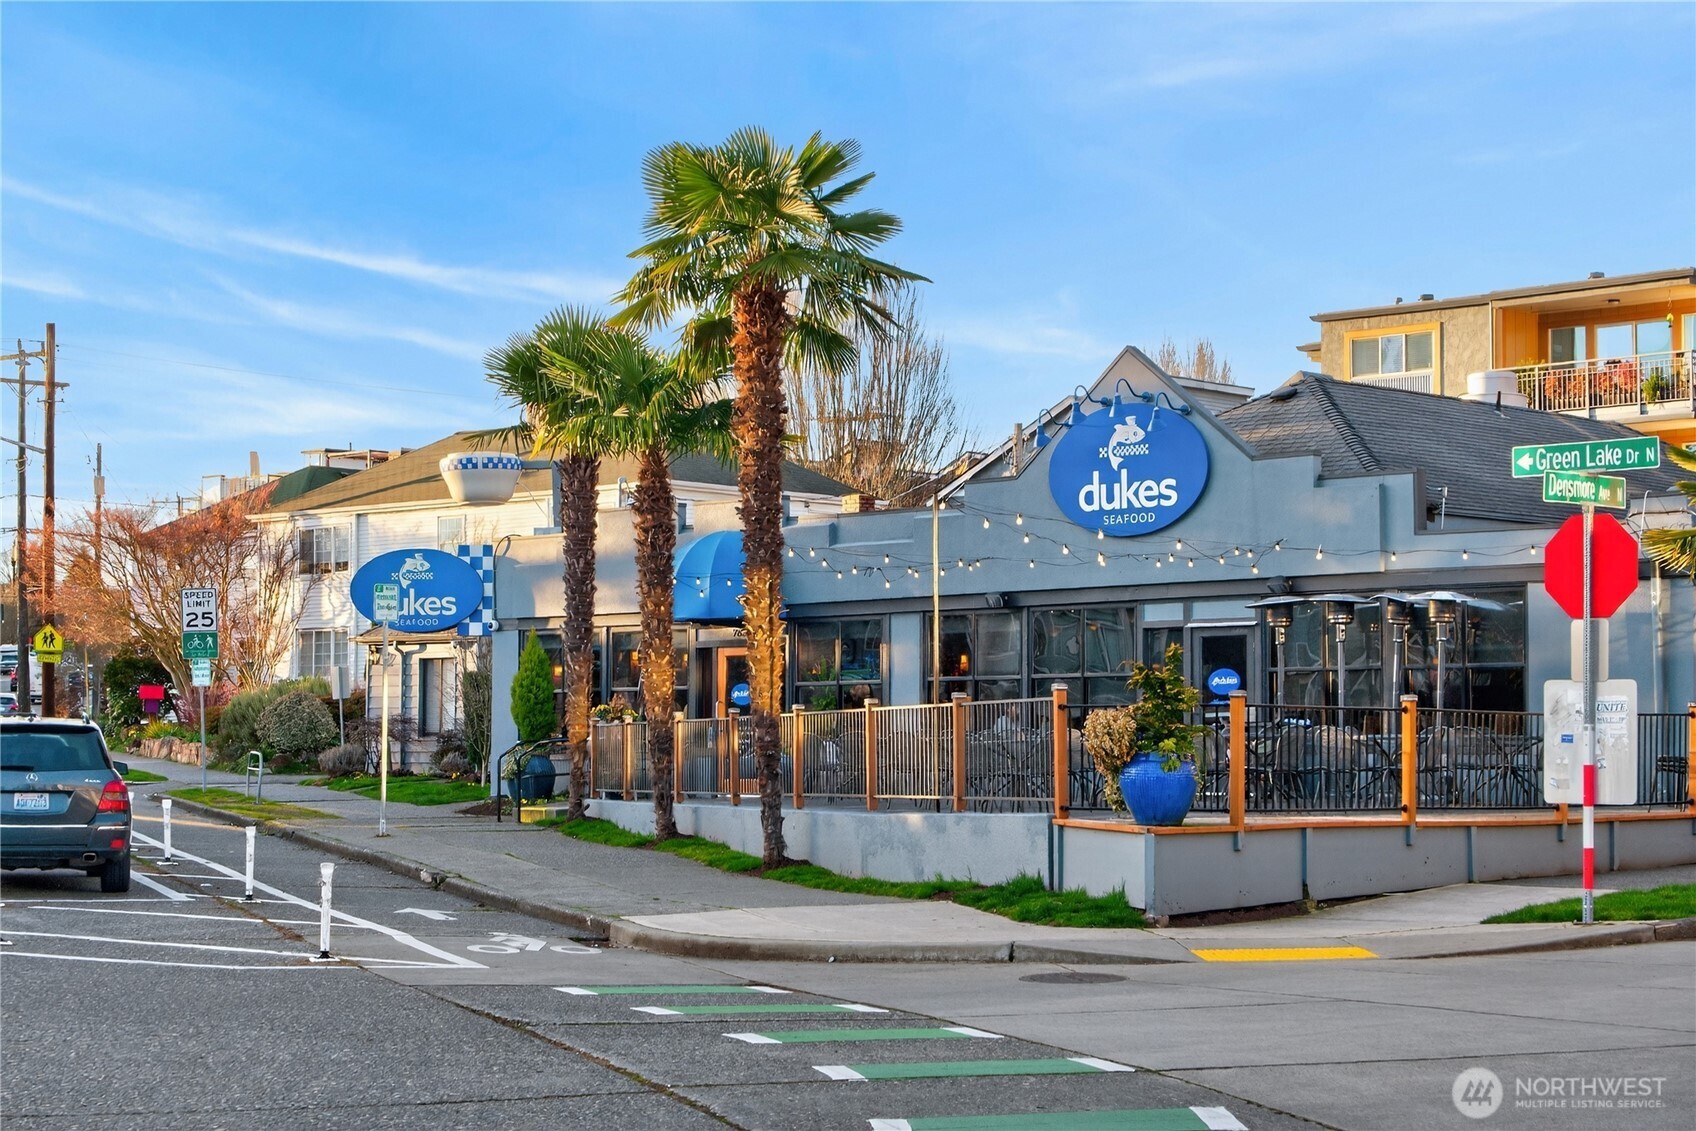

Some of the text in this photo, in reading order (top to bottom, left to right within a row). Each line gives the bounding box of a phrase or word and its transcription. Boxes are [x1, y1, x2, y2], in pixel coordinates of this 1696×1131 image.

[1535, 444, 1655, 471] Green Lake Dr N
[1078, 468, 1178, 512] dukes
[1548, 473, 1596, 500] Densmore
[1616, 487, 1623, 502] N
[1103, 512, 1156, 525] SEAFOOD
[183, 591, 214, 599] SPEED
[187, 600, 211, 608] LIMIT
[398, 588, 457, 616] ukes
[186, 611, 214, 628] 25
